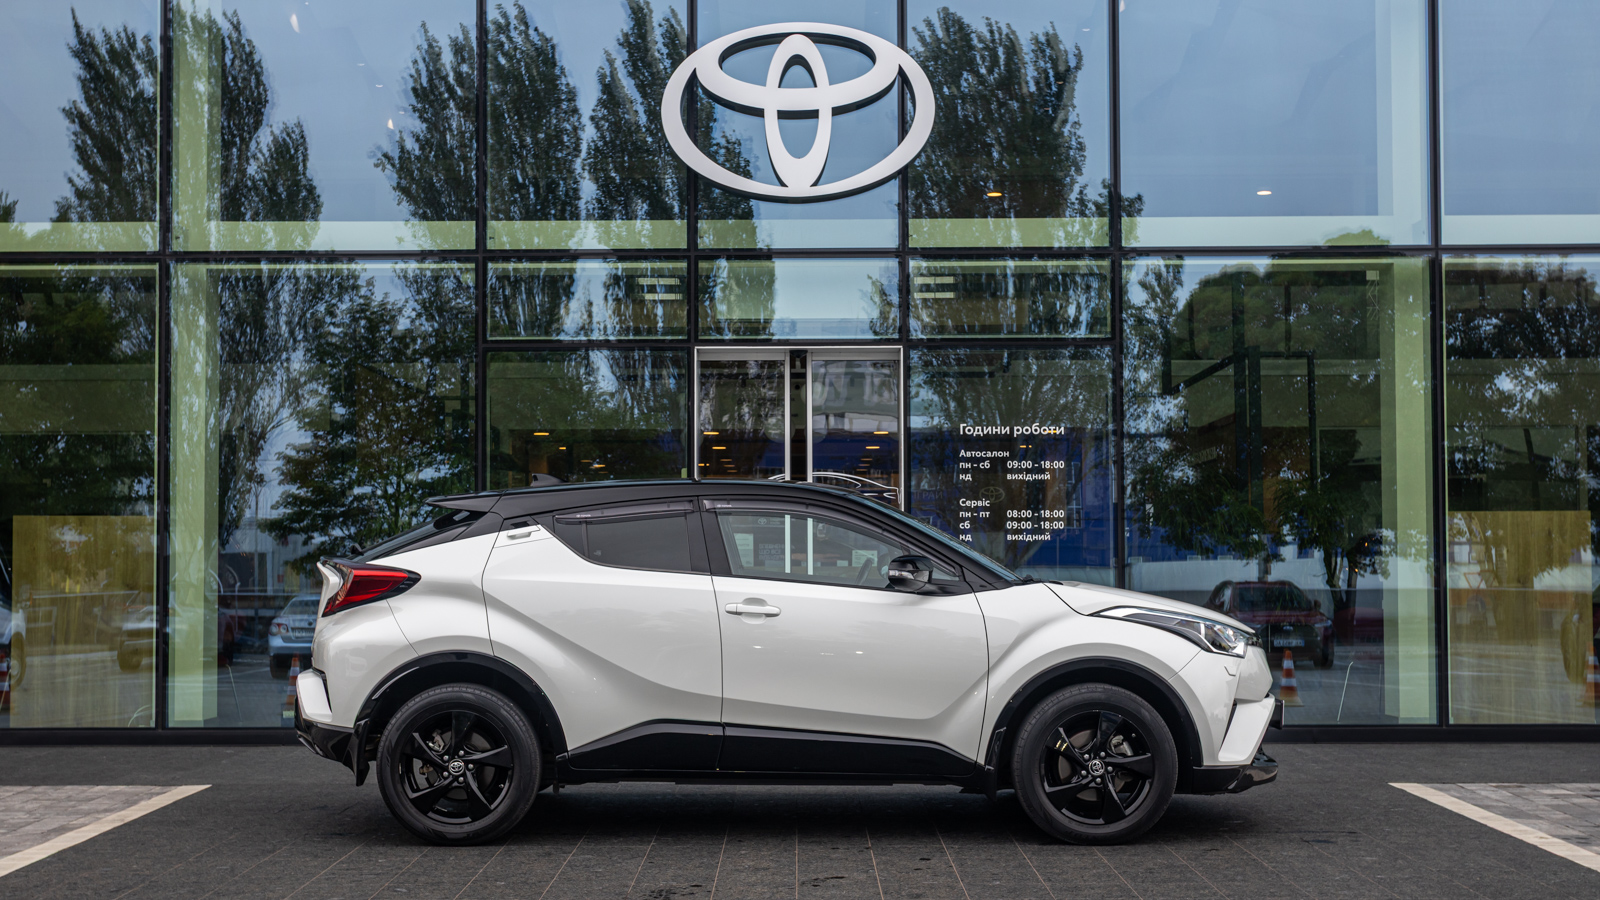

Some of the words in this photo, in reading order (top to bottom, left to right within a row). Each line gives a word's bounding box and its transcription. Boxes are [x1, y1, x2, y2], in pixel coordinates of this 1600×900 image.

[959, 423, 1010, 437] Години
[1013, 423, 1065, 438] роботи
[959, 449, 1010, 458] Автосалон
[979, 460, 991, 469] сб
[1006, 460, 1033, 469] 09:00
[1040, 460, 1065, 469] 18:00
[959, 473, 973, 481] нд
[1006, 471, 1051, 481] вихідний
[959, 498, 991, 508] Сервіс
[1006, 509, 1033, 518] 08:00
[1040, 509, 1065, 518] 18:00
[959, 521, 971, 529] сб
[1006, 521, 1033, 529] 09:00
[1040, 521, 1065, 529] 18:00
[959, 533, 973, 542] нд
[1006, 532, 1051, 542] вихідний
